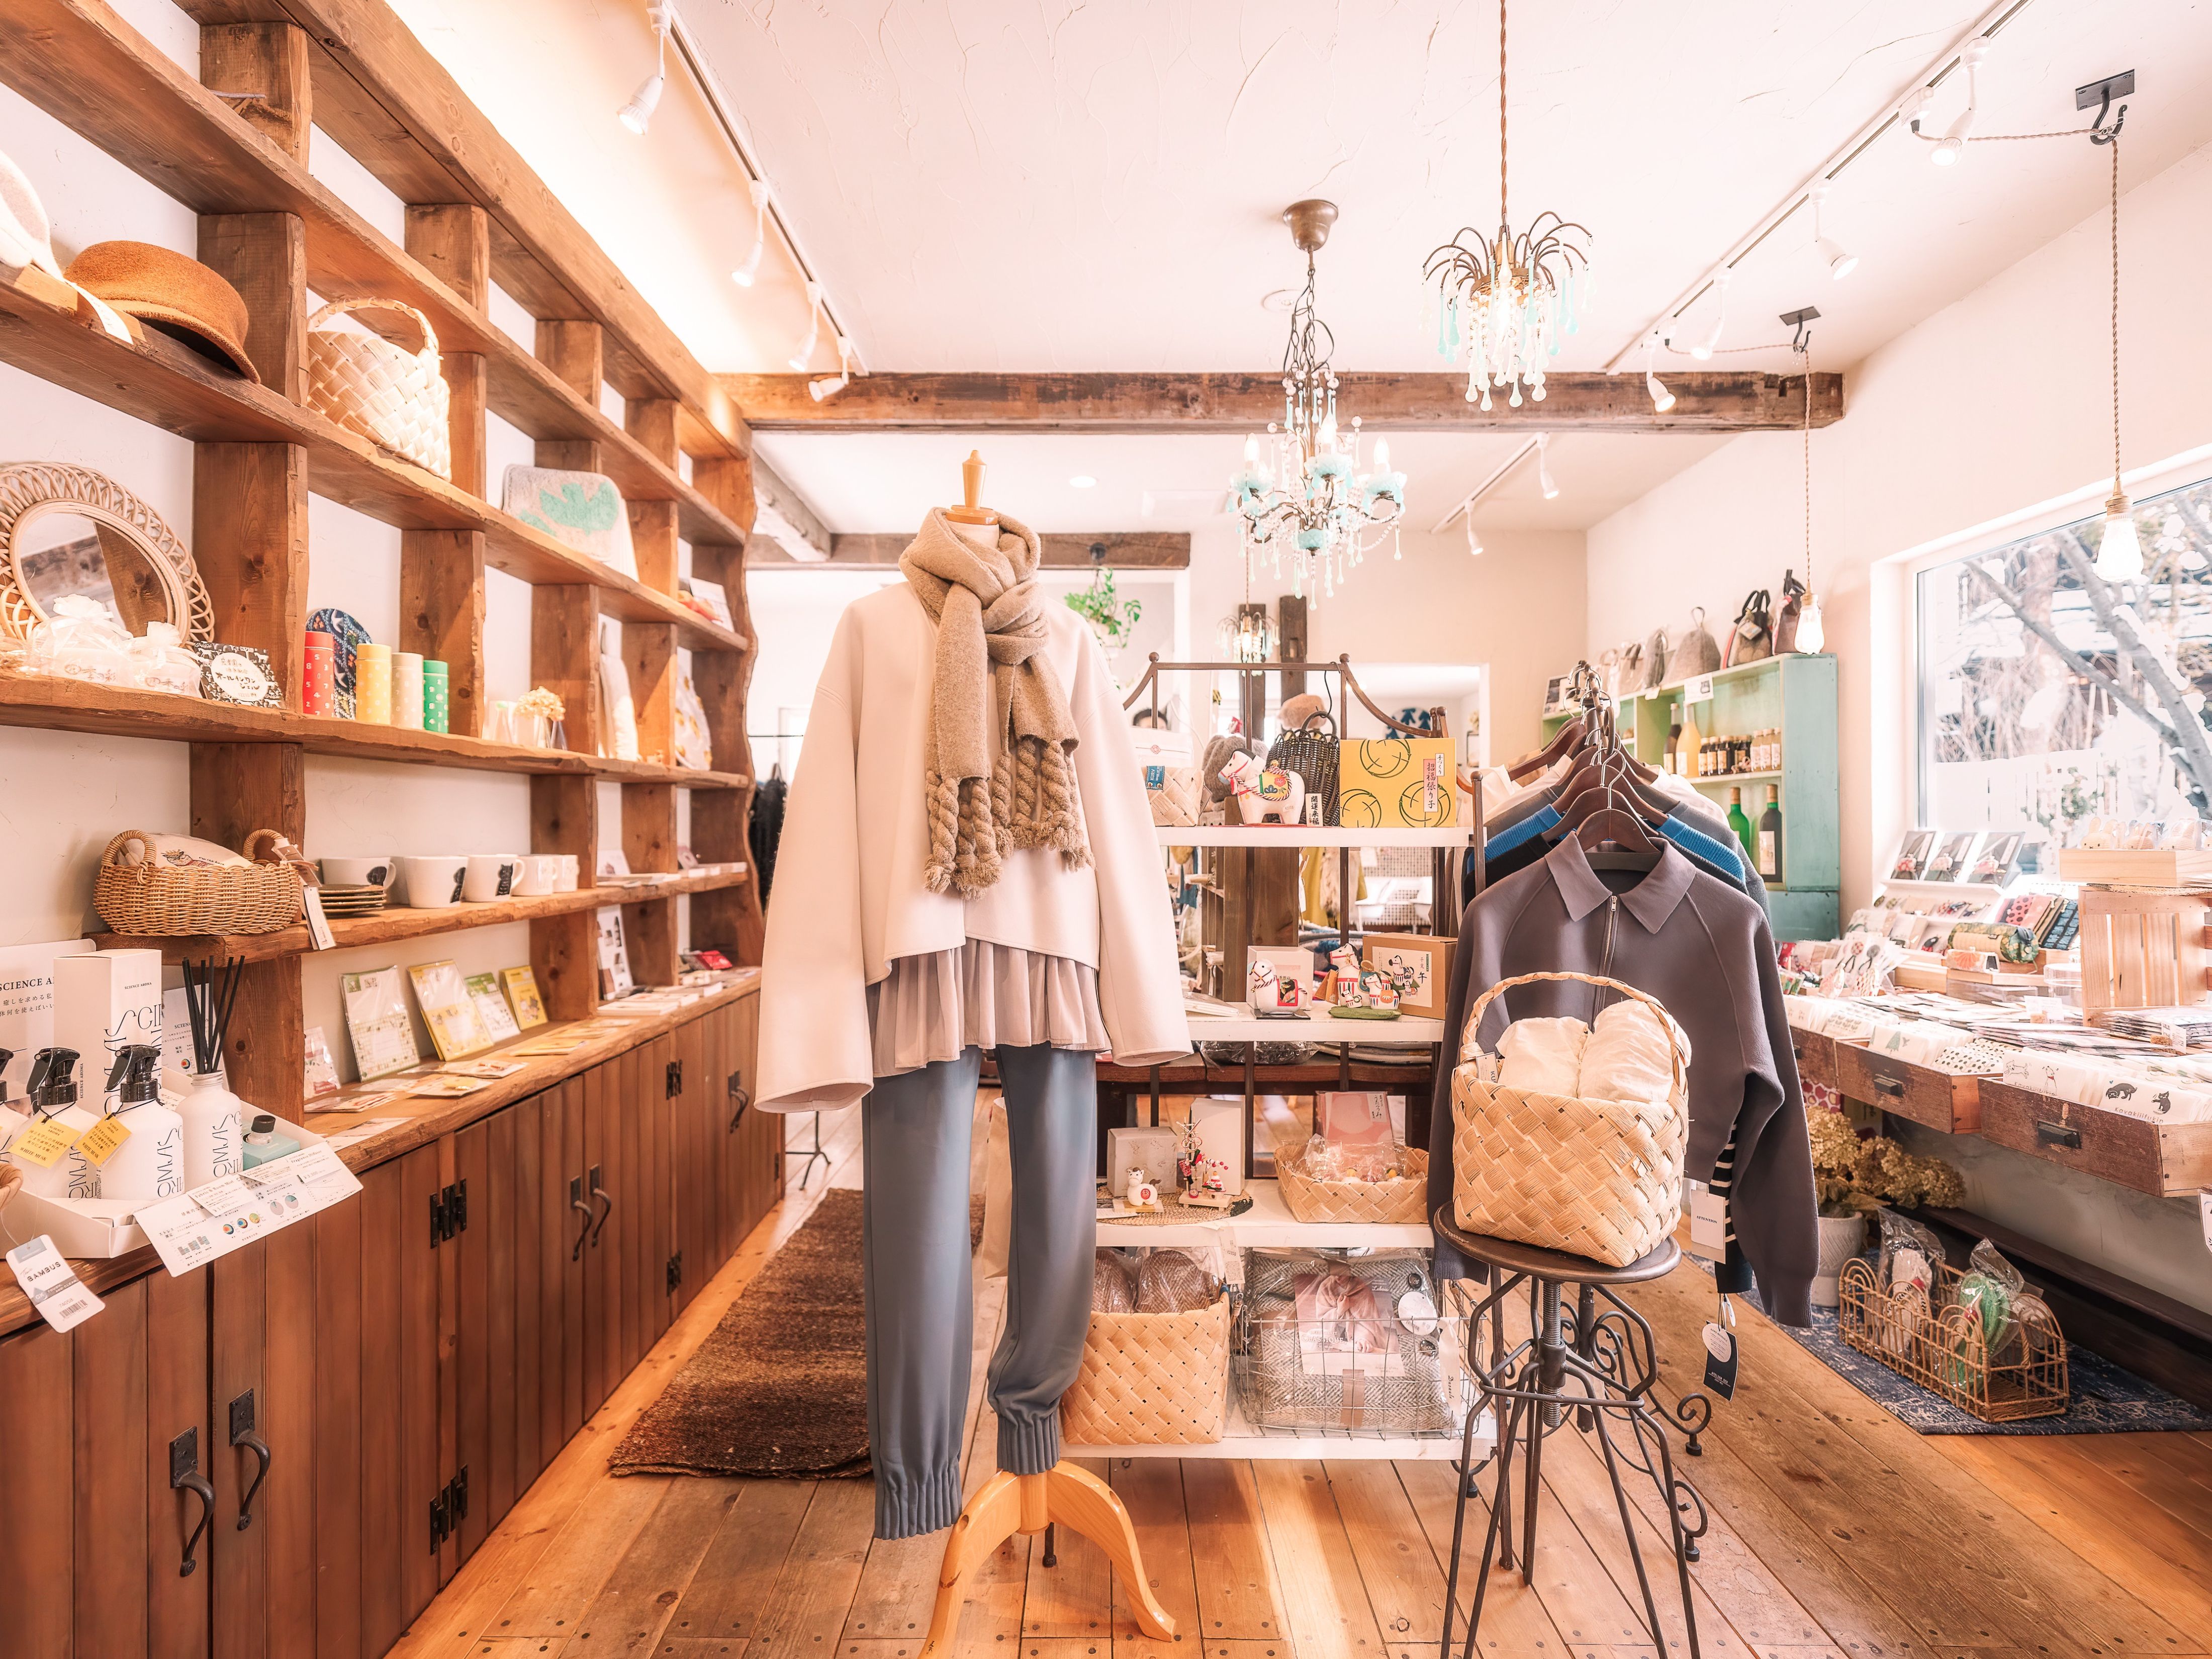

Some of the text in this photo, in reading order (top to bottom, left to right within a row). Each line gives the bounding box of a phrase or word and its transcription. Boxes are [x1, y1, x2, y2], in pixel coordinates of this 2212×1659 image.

[1427, 762, 1436, 809] 招福張り子
[1311, 796, 1319, 824] 開運来福
[1418, 972, 1427, 984] 午
[21, 1147, 34, 1156] WHITE
[82, 1142, 99, 1158] WHITE MUSK
[1697, 1216, 1717, 1224] ATTENTION
[27, 1262, 61, 1282] BAMBUS
